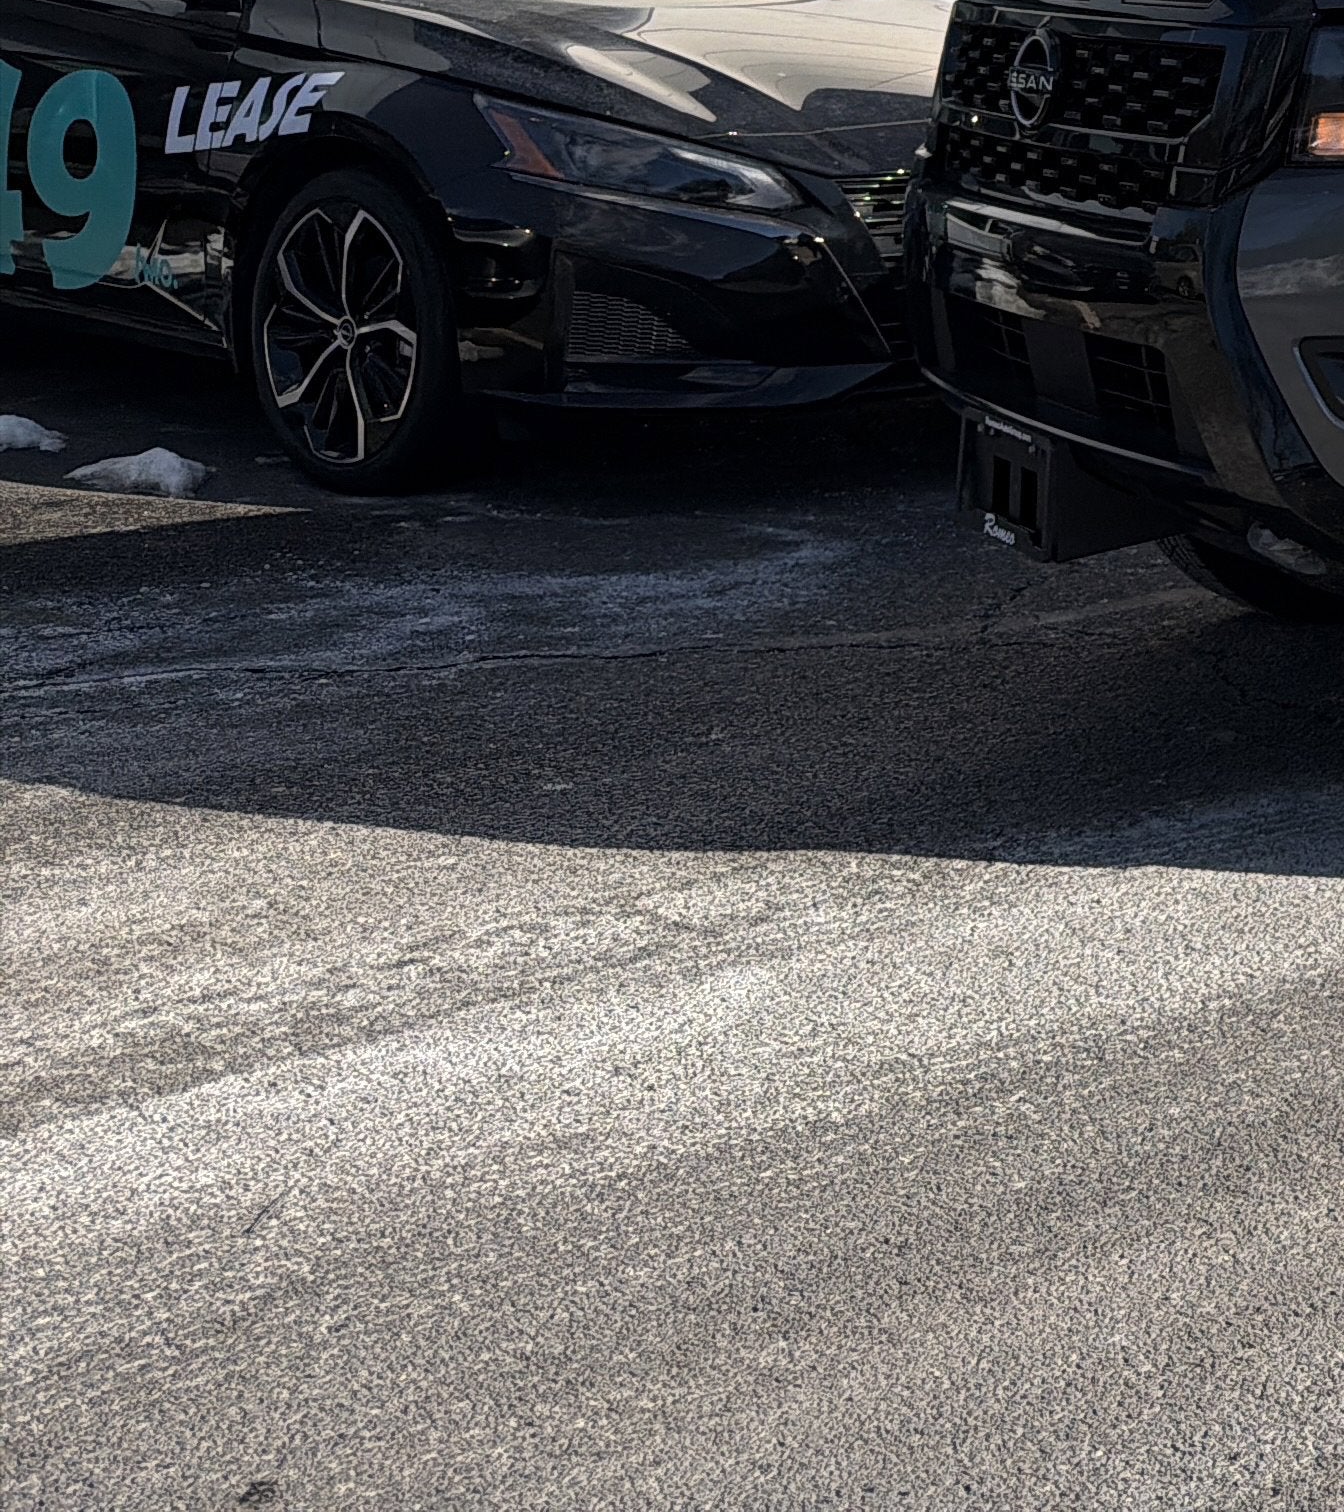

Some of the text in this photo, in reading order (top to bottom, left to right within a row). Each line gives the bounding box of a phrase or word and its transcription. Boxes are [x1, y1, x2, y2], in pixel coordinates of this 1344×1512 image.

[164, 71, 346, 154] LEASE
[0, 58, 138, 290] 9
[983, 512, 1016, 546] Romeo
